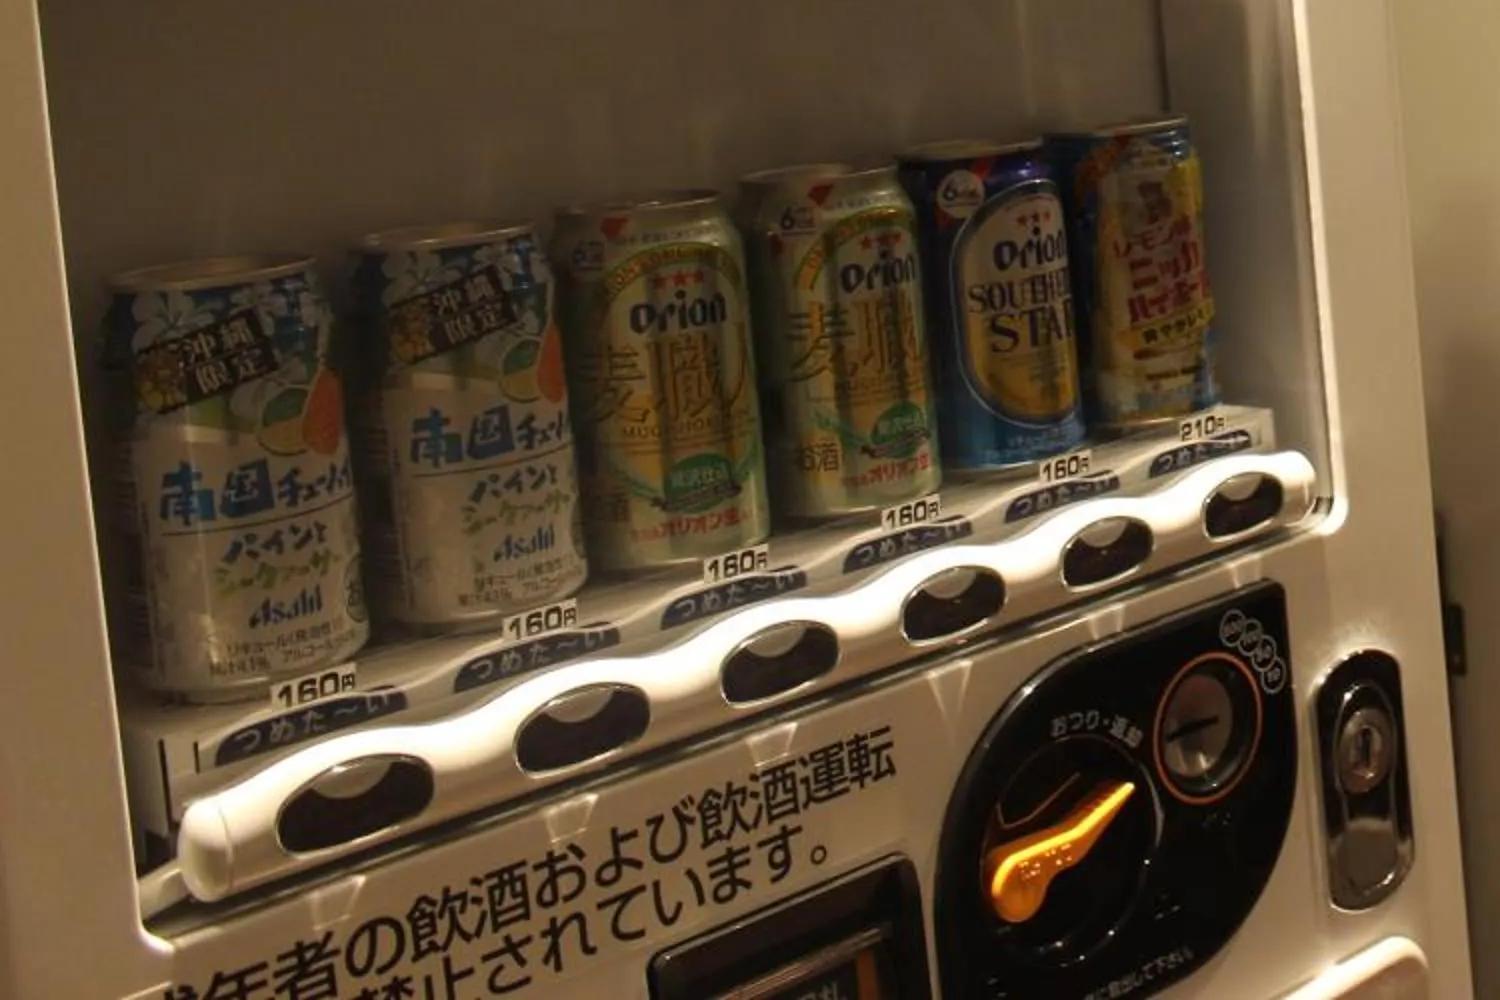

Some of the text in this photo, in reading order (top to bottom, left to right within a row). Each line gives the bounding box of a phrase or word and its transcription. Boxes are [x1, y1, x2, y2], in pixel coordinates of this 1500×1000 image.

[841, 249, 916, 294] Orion
[630, 289, 728, 335] Orion
[1042, 455, 1089, 480] 160円
[886, 500, 940, 529] 160円
[707, 549, 768, 582] 160円
[509, 606, 578, 640] 160円
[277, 671, 356, 708] 160円
